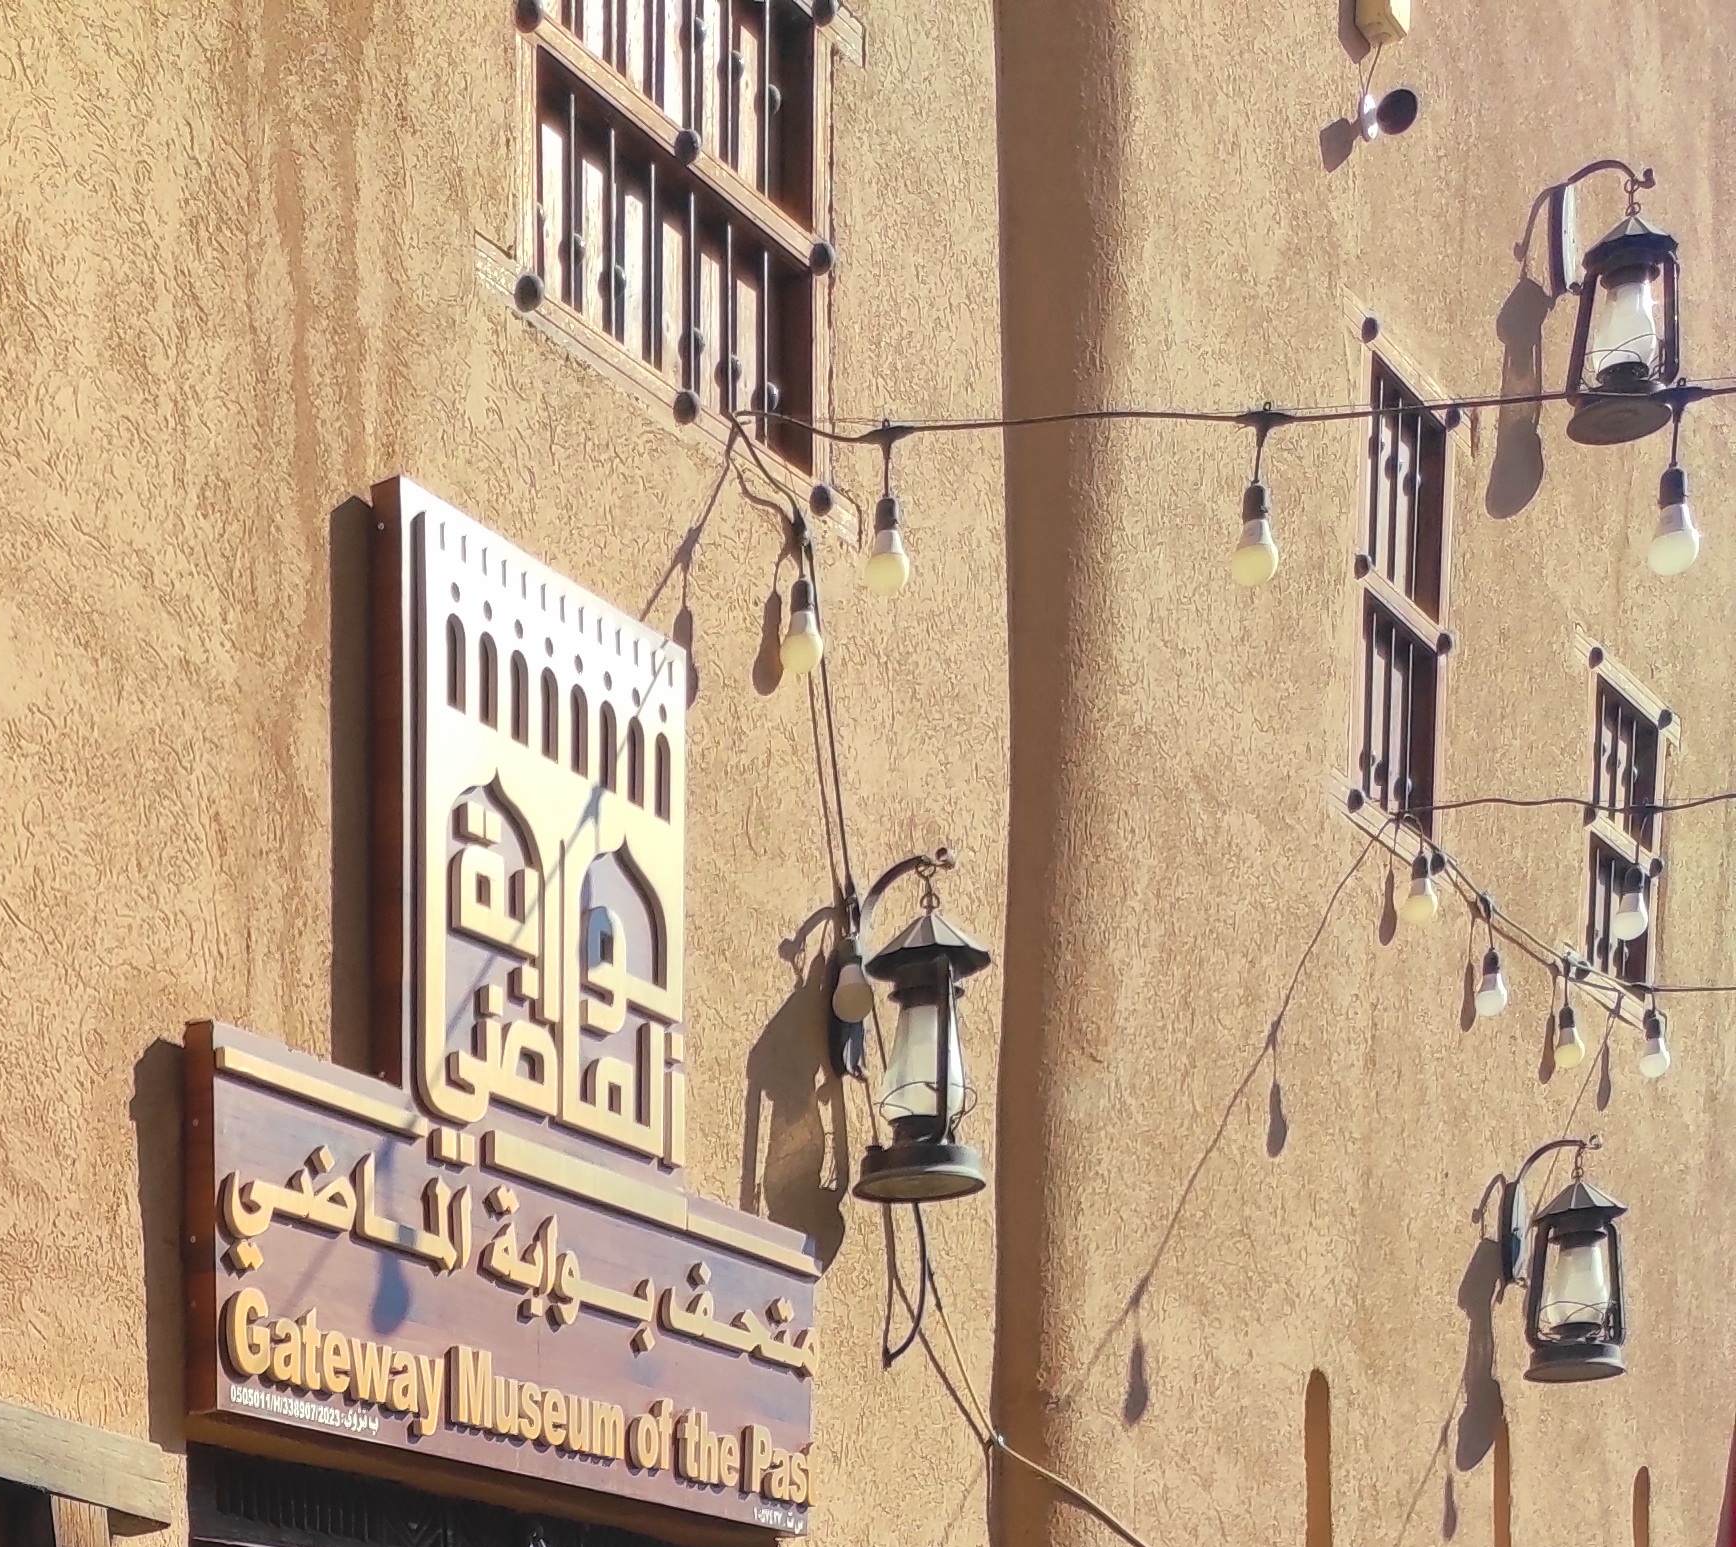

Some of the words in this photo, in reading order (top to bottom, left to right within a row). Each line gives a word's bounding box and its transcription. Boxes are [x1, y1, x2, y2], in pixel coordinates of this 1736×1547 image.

[221, 1146, 471, 1273] الماضي
[481, 1188, 655, 1357] بوابة
[663, 1262, 818, 1377] متحف
[227, 1287, 446, 1437] Gateway
[446, 1346, 625, 1460] Museum
[633, 1400, 674, 1470] of
[679, 1408, 738, 1489] the
[744, 1425, 818, 1507] Past
